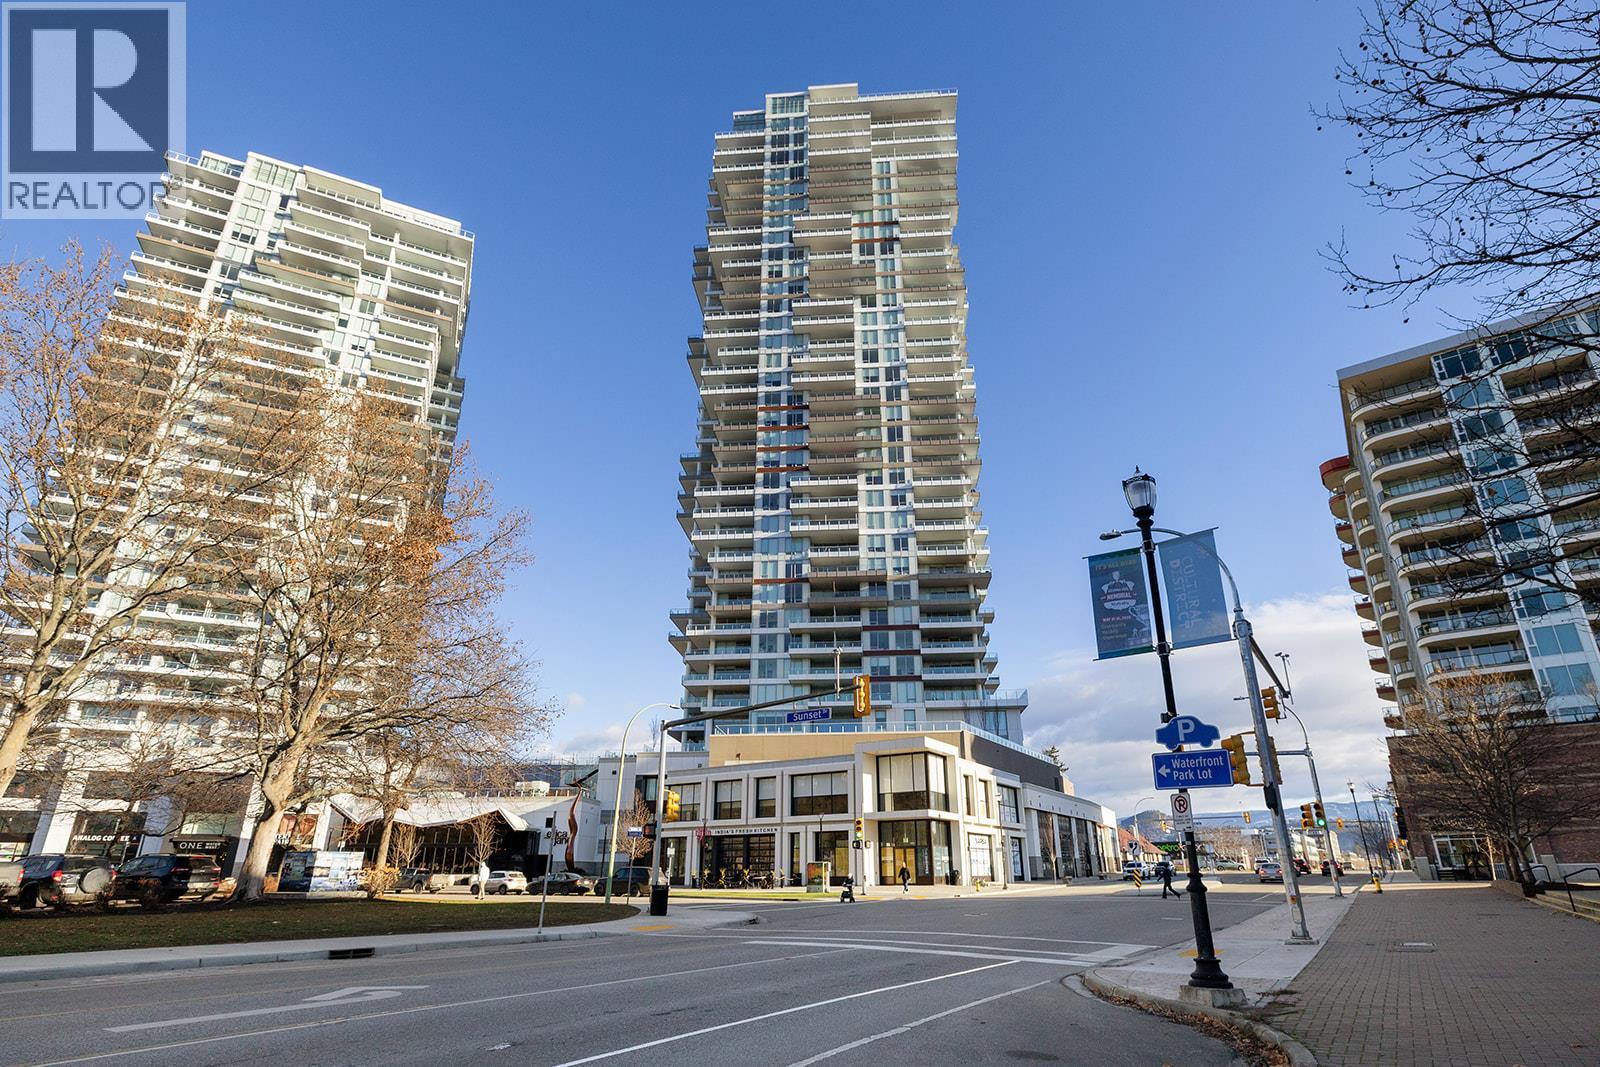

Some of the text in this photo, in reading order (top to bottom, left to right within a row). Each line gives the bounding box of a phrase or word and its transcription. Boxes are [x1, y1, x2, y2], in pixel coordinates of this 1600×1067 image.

[793, 710, 822, 721] Sunset
[1177, 718, 1195, 742] P
[1171, 756, 1224, 769] Waterfront
[1173, 768, 1213, 781] Park Lot
[546, 830, 568, 838] eica
[180, 841, 203, 849] ONE
